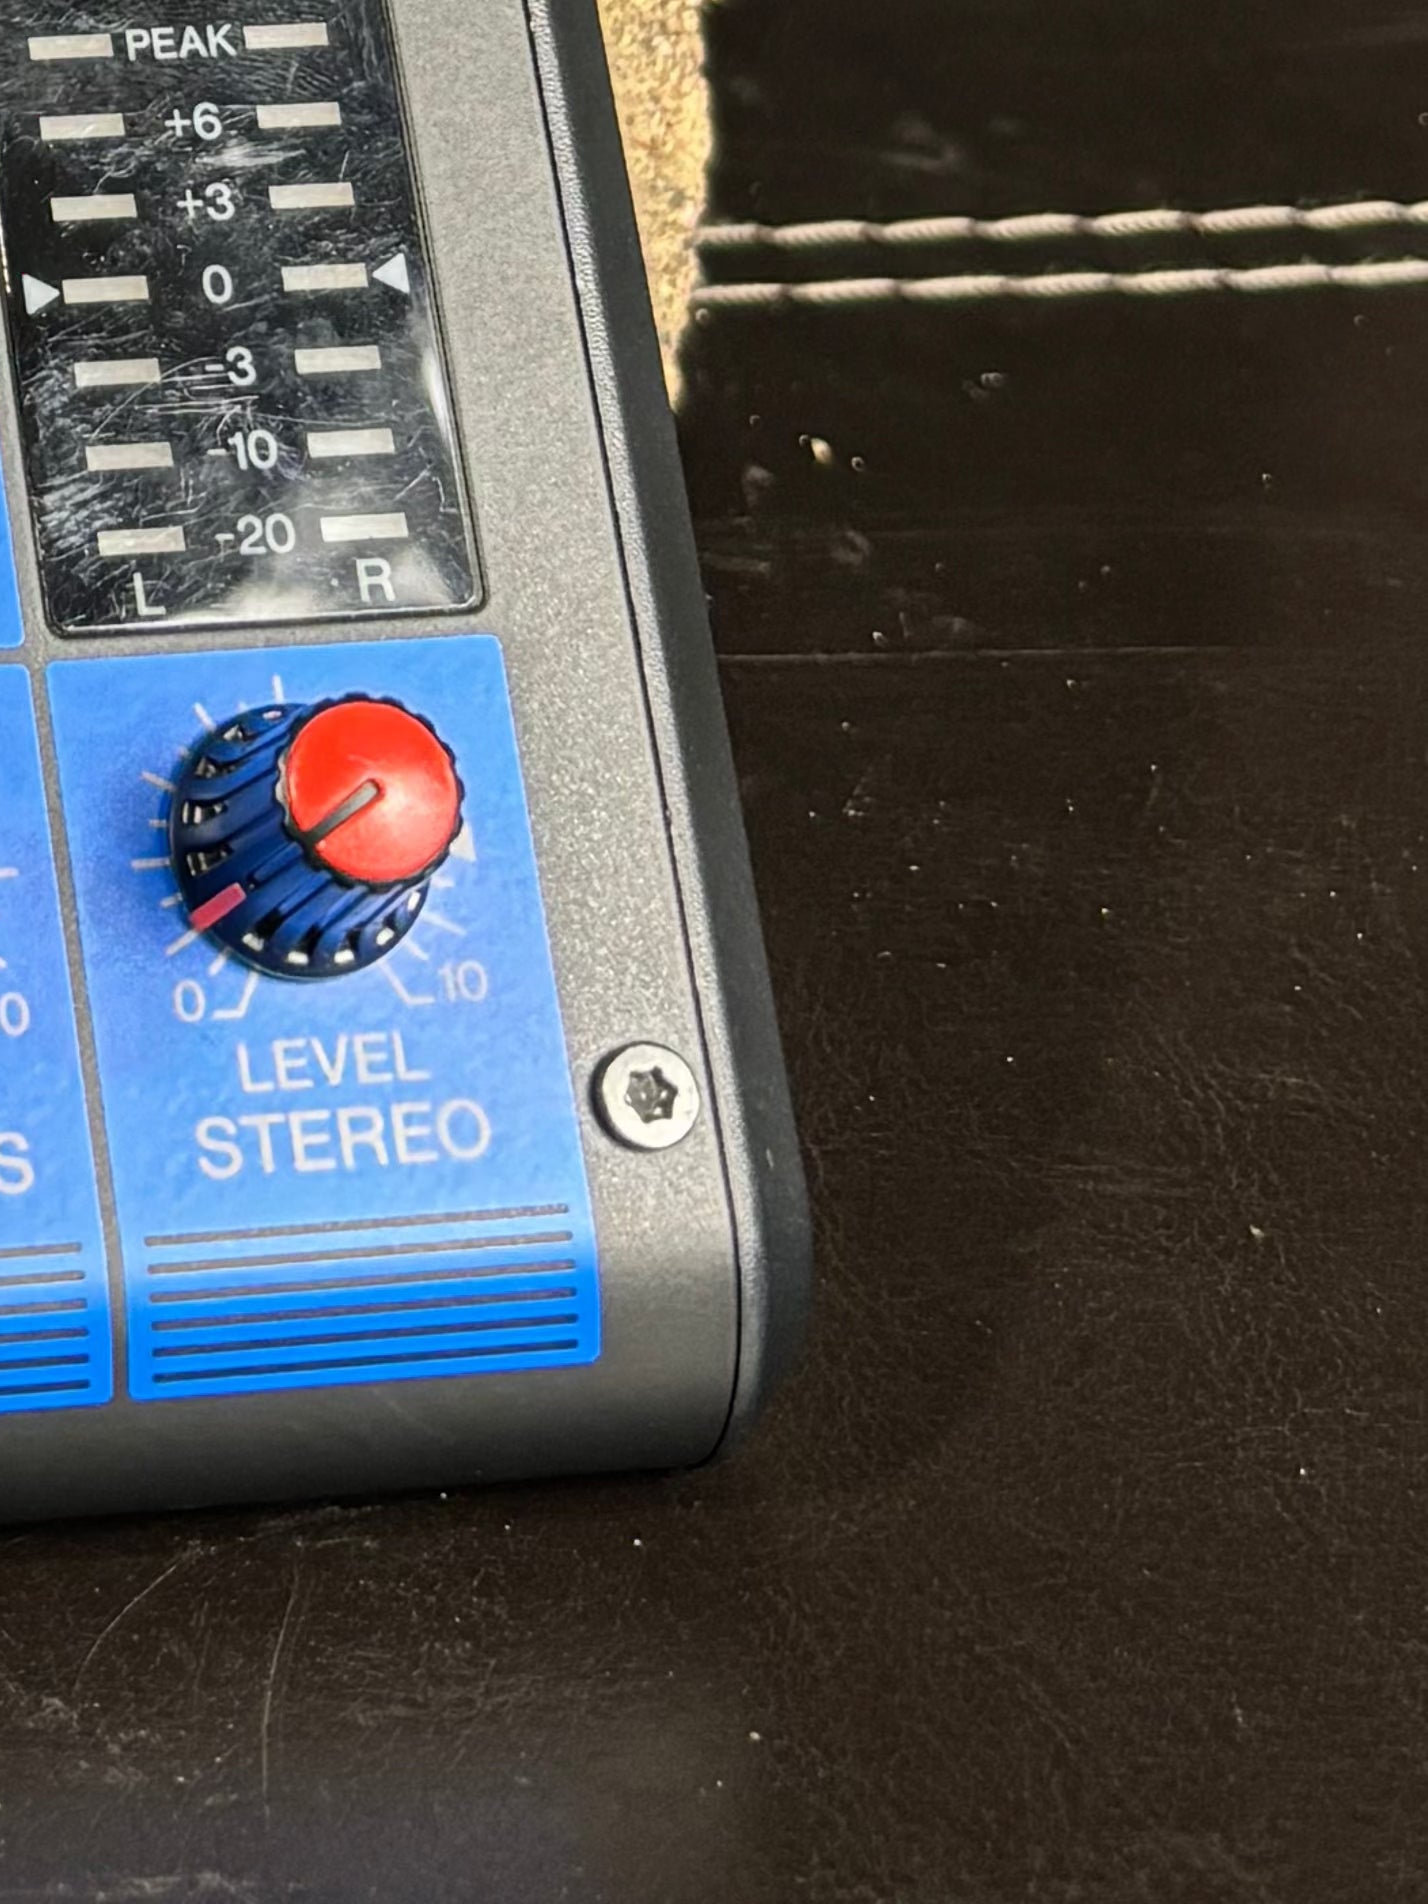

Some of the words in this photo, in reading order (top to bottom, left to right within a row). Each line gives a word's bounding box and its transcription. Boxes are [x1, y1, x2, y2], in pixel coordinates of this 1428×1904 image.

[124, 23, 238, 62] PEAK
[164, 101, 223, 141] +6
[176, 182, 239, 225] +3
[202, 264, 233, 305] 0
[204, 348, 256, 387] -3
[206, 430, 279, 470] -10
[215, 513, 297, 556] -20
[132, 572, 167, 617] L
[356, 557, 395, 602] R
[173, 979, 207, 1023] 0
[437, 959, 489, 1003] 10
[237, 1029, 432, 1093] LEVEL
[195, 1098, 494, 1180] STEREO
